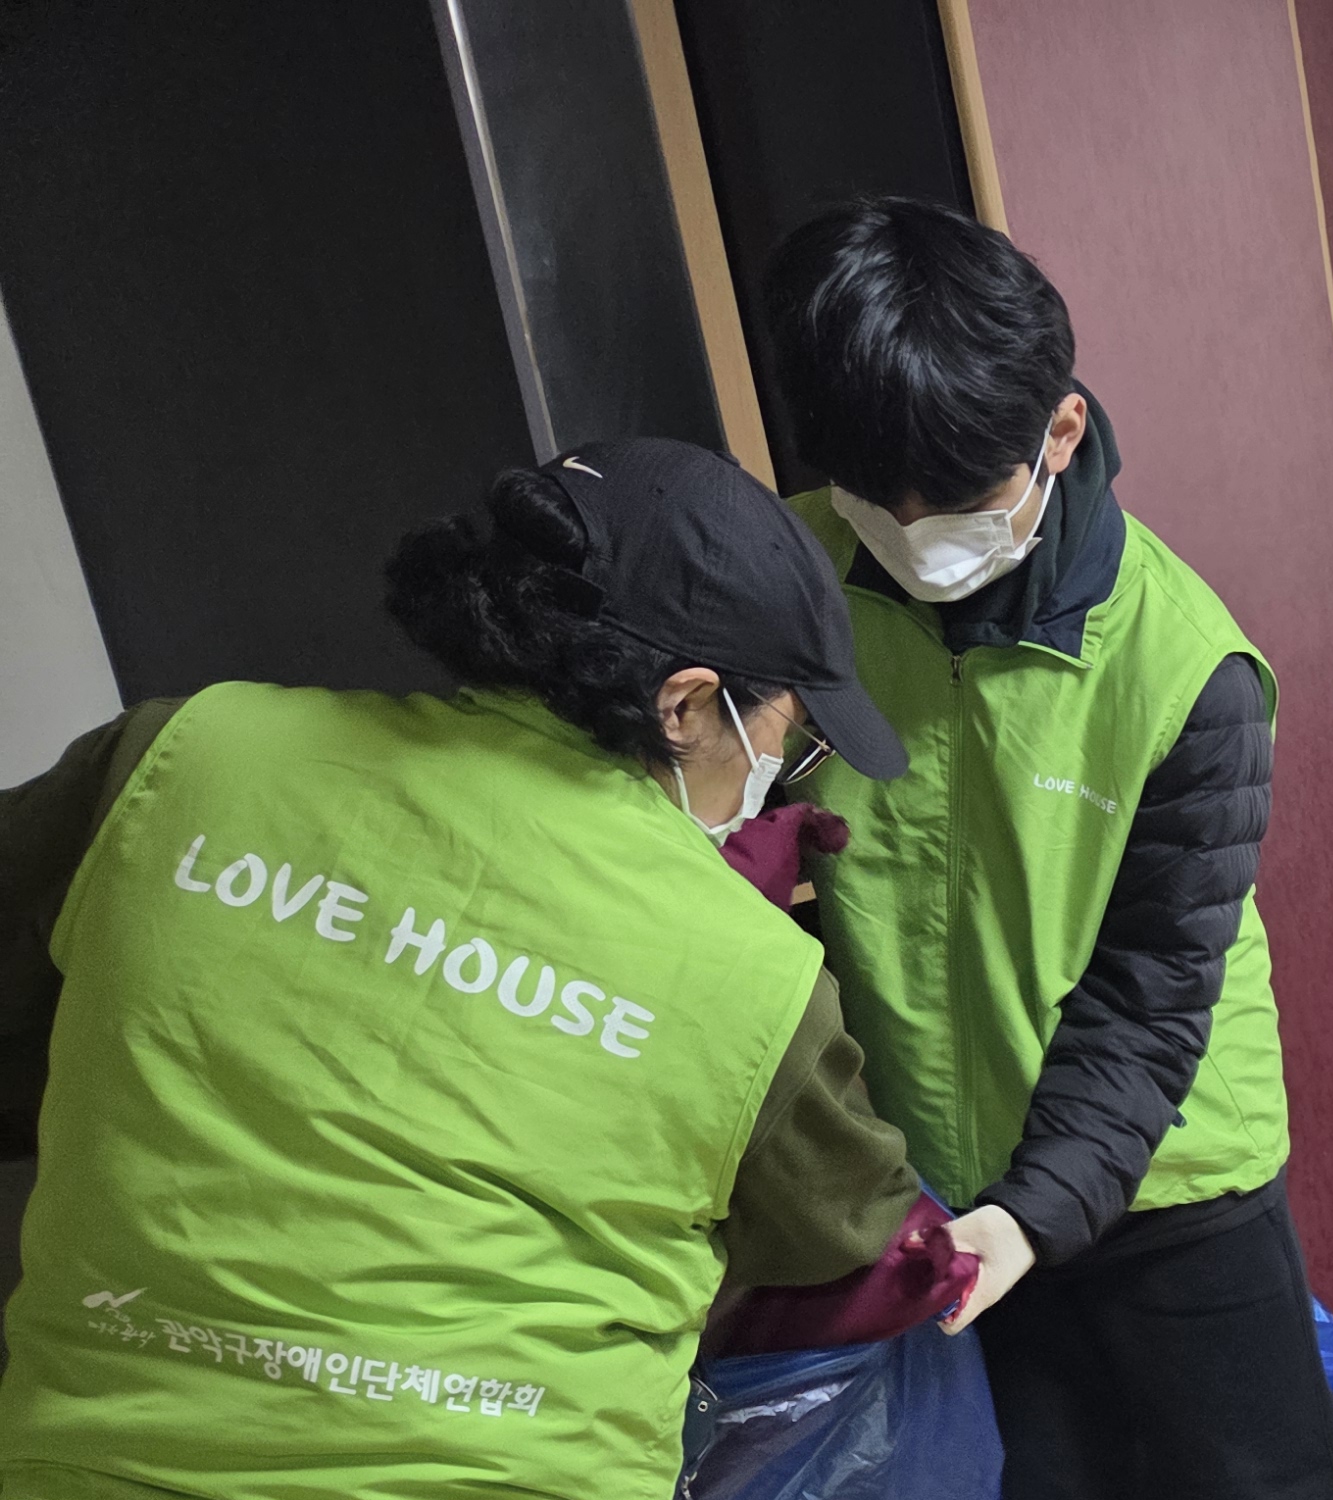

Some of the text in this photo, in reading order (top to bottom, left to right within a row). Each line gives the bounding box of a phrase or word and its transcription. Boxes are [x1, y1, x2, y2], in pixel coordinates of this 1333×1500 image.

[1033, 772, 1117, 815] LOVE HOUSE
[174, 833, 656, 1059] LOVE HOUSE
[154, 1317, 546, 1418] 관악구장애인단체연합회
